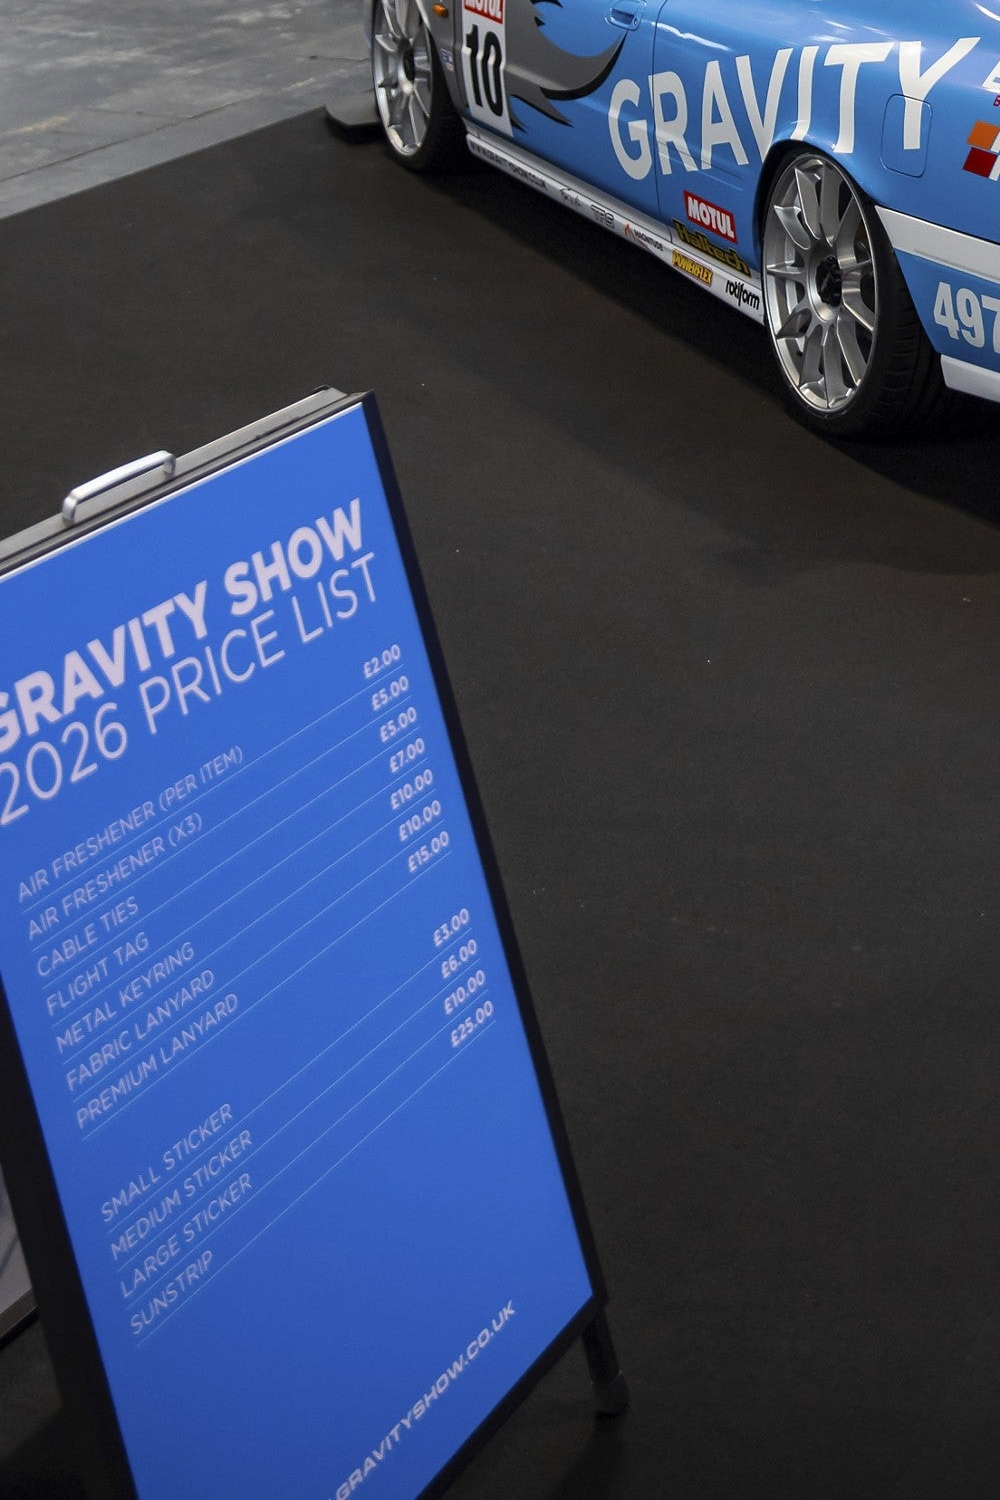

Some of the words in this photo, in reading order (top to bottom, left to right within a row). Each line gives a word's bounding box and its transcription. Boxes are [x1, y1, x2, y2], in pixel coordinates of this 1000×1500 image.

[466, 24, 503, 117] 10
[608, 36, 981, 181] GRAVITY
[672, 218, 751, 278] Haltech
[672, 250, 713, 286] POWERFLEX
[687, 195, 735, 239] MOTUL
[725, 279, 760, 310] rotiform
[0, 701, 129, 826] 2026
[139, 609, 286, 735] PRICE
[291, 552, 378, 645] LIST
[224, 497, 363, 616] SHOW
[17, 871, 49, 903] AIR
[52, 800, 155, 880] FRESHENER
[158, 773, 198, 813] (PER
[199, 744, 244, 785] ITEM)
[363, 644, 402, 680] £2.00
[27, 906, 59, 941] AIR
[61, 833, 166, 915] FRESHENER
[168, 812, 203, 848] (X3)
[371, 675, 409, 711] £5.00
[37, 923, 98, 978] CABLE
[99, 897, 140, 931] TIES
[379, 706, 418, 743] £5.00
[46, 957, 110, 1016] FLIGHT
[113, 932, 150, 966] TAG
[388, 736, 426, 773] £7.00
[56, 1003, 117, 1054] METAL
[120, 942, 196, 1009] KEYRING
[389, 768, 435, 811] £10.00
[65, 1030, 132, 1092] FABRIC
[136, 969, 216, 1041] LANYARD
[398, 799, 443, 843] £10.00
[76, 1056, 159, 1130] PREMIUM
[160, 993, 240, 1065] LANYARD
[407, 830, 450, 873] £15.00
[101, 1166, 161, 1224] SMALL
[162, 1102, 234, 1172] STICKER
[432, 907, 471, 948] £3.00
[110, 1188, 182, 1261] MEDIUM
[183, 1129, 253, 1197] STICKER
[440, 938, 479, 979] £6.00
[120, 1239, 181, 1300] LARGE
[183, 1172, 253, 1243] STICKER
[443, 969, 487, 1016] £10.00
[130, 1249, 214, 1336] SUNSTRIP
[450, 1000, 495, 1048] £25.00
